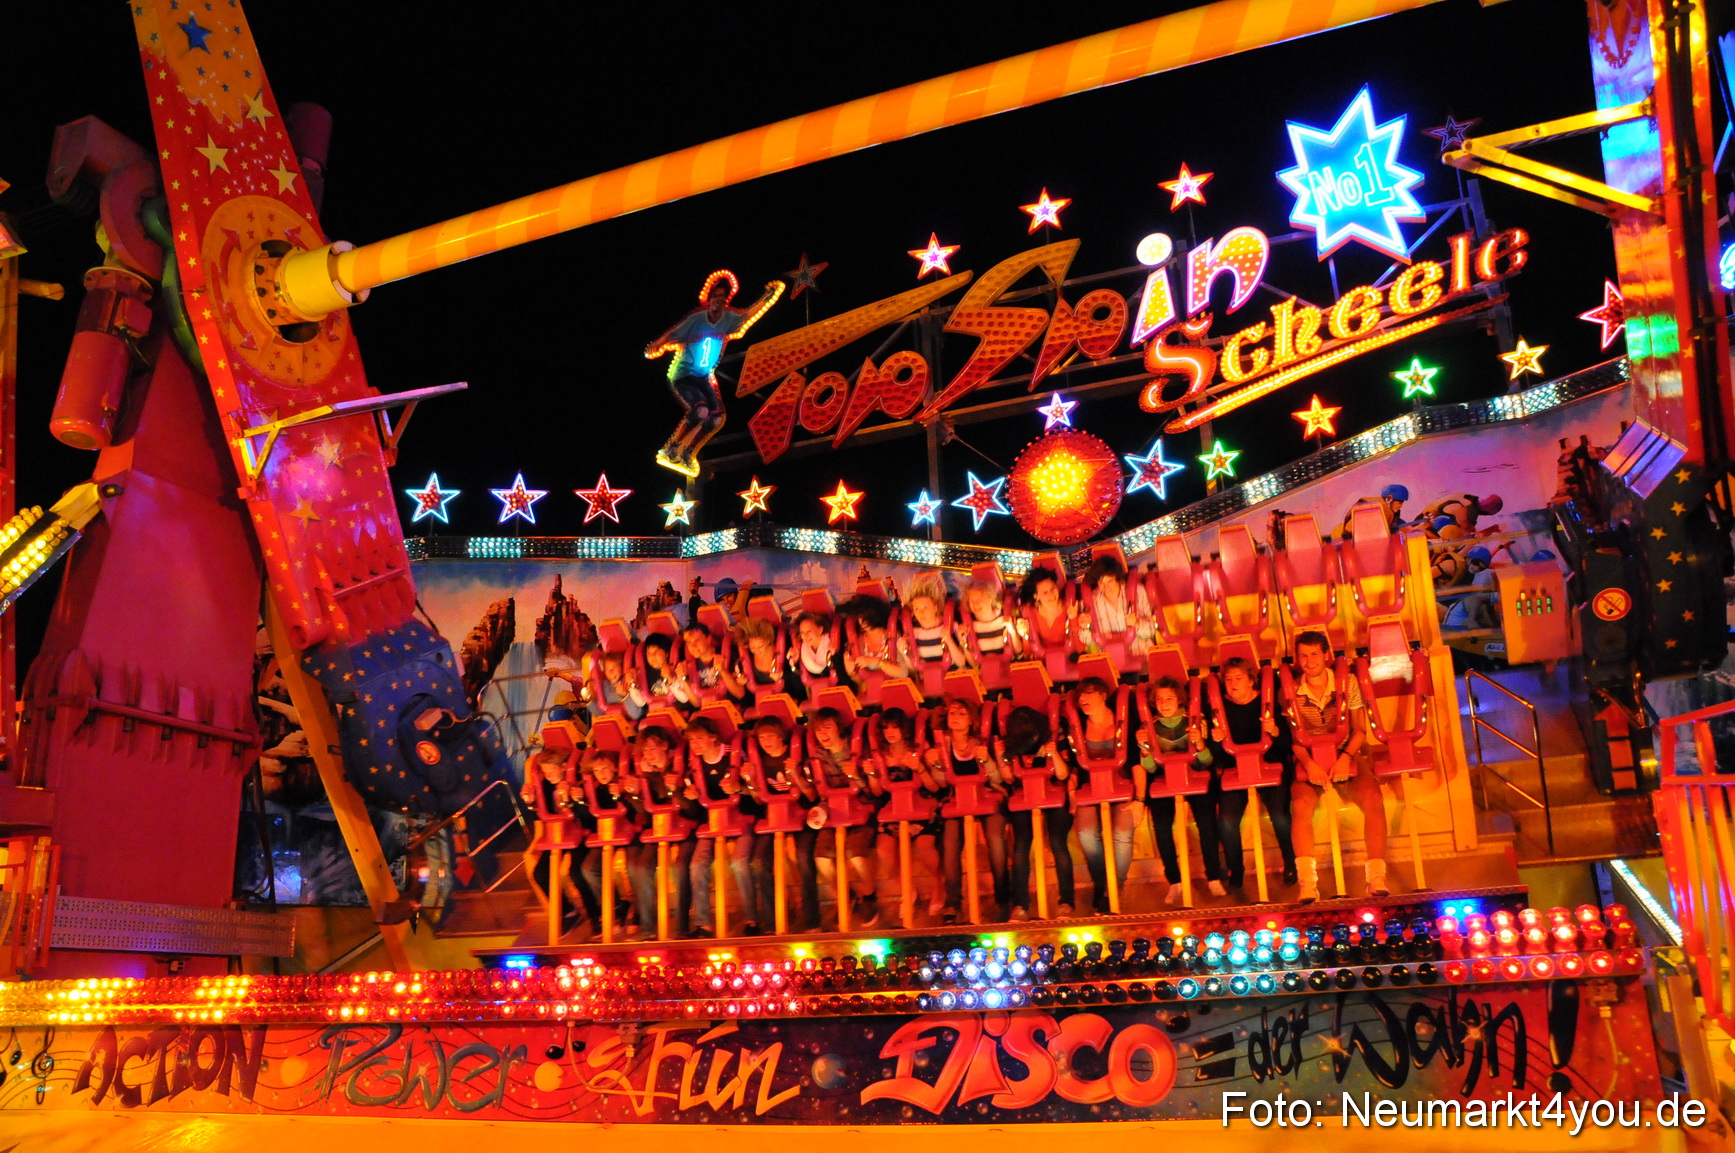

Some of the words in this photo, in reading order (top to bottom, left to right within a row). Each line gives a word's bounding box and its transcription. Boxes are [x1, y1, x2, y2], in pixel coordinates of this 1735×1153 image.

[698, 336, 714, 366] 1
[915, 227, 1270, 422] Spin
[1139, 227, 1530, 414] Scheele
[318, 1023, 527, 1112] Power
[1247, 1004, 1311, 1083] der
